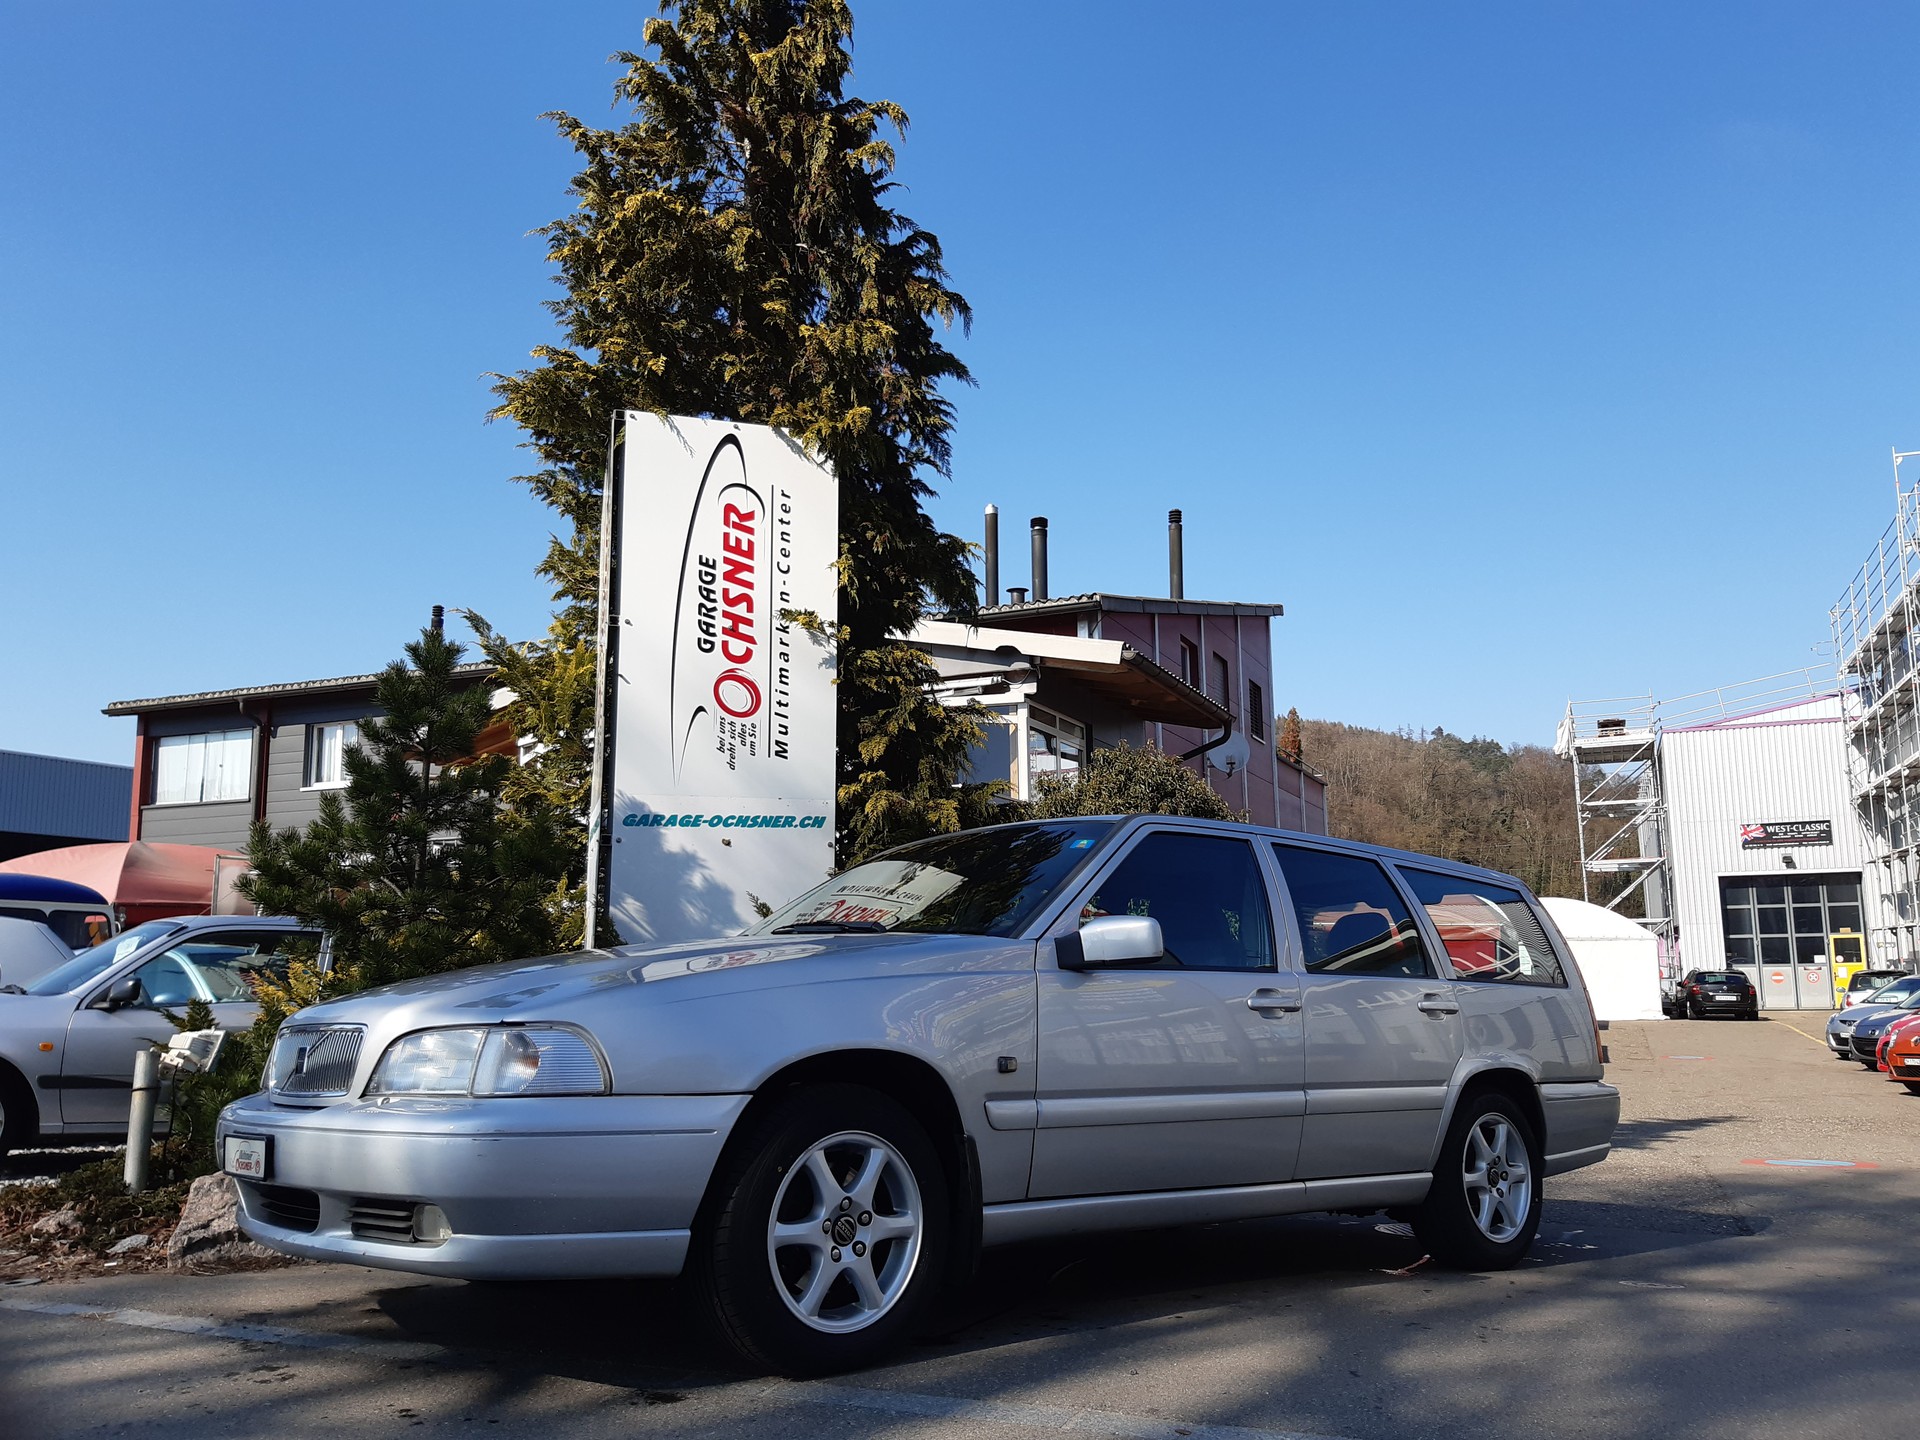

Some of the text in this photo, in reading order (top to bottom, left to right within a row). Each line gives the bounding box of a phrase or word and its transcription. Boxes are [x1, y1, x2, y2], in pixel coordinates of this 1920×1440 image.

[697, 554, 718, 654] GARAGE
[713, 502, 762, 718] OCHSNER
[775, 489, 791, 760] Multimarkn-Center
[716, 735, 726, 754] bei
[726, 720, 737, 771] dreht sich
[738, 722, 747, 747] alles
[748, 722, 757, 757] um Sie
[622, 813, 827, 829] GARAGE-OCHSNER.CH
[1766, 822, 1830, 833] WEST-CLASSIC
[837, 1221, 852, 1240] VOLVO
